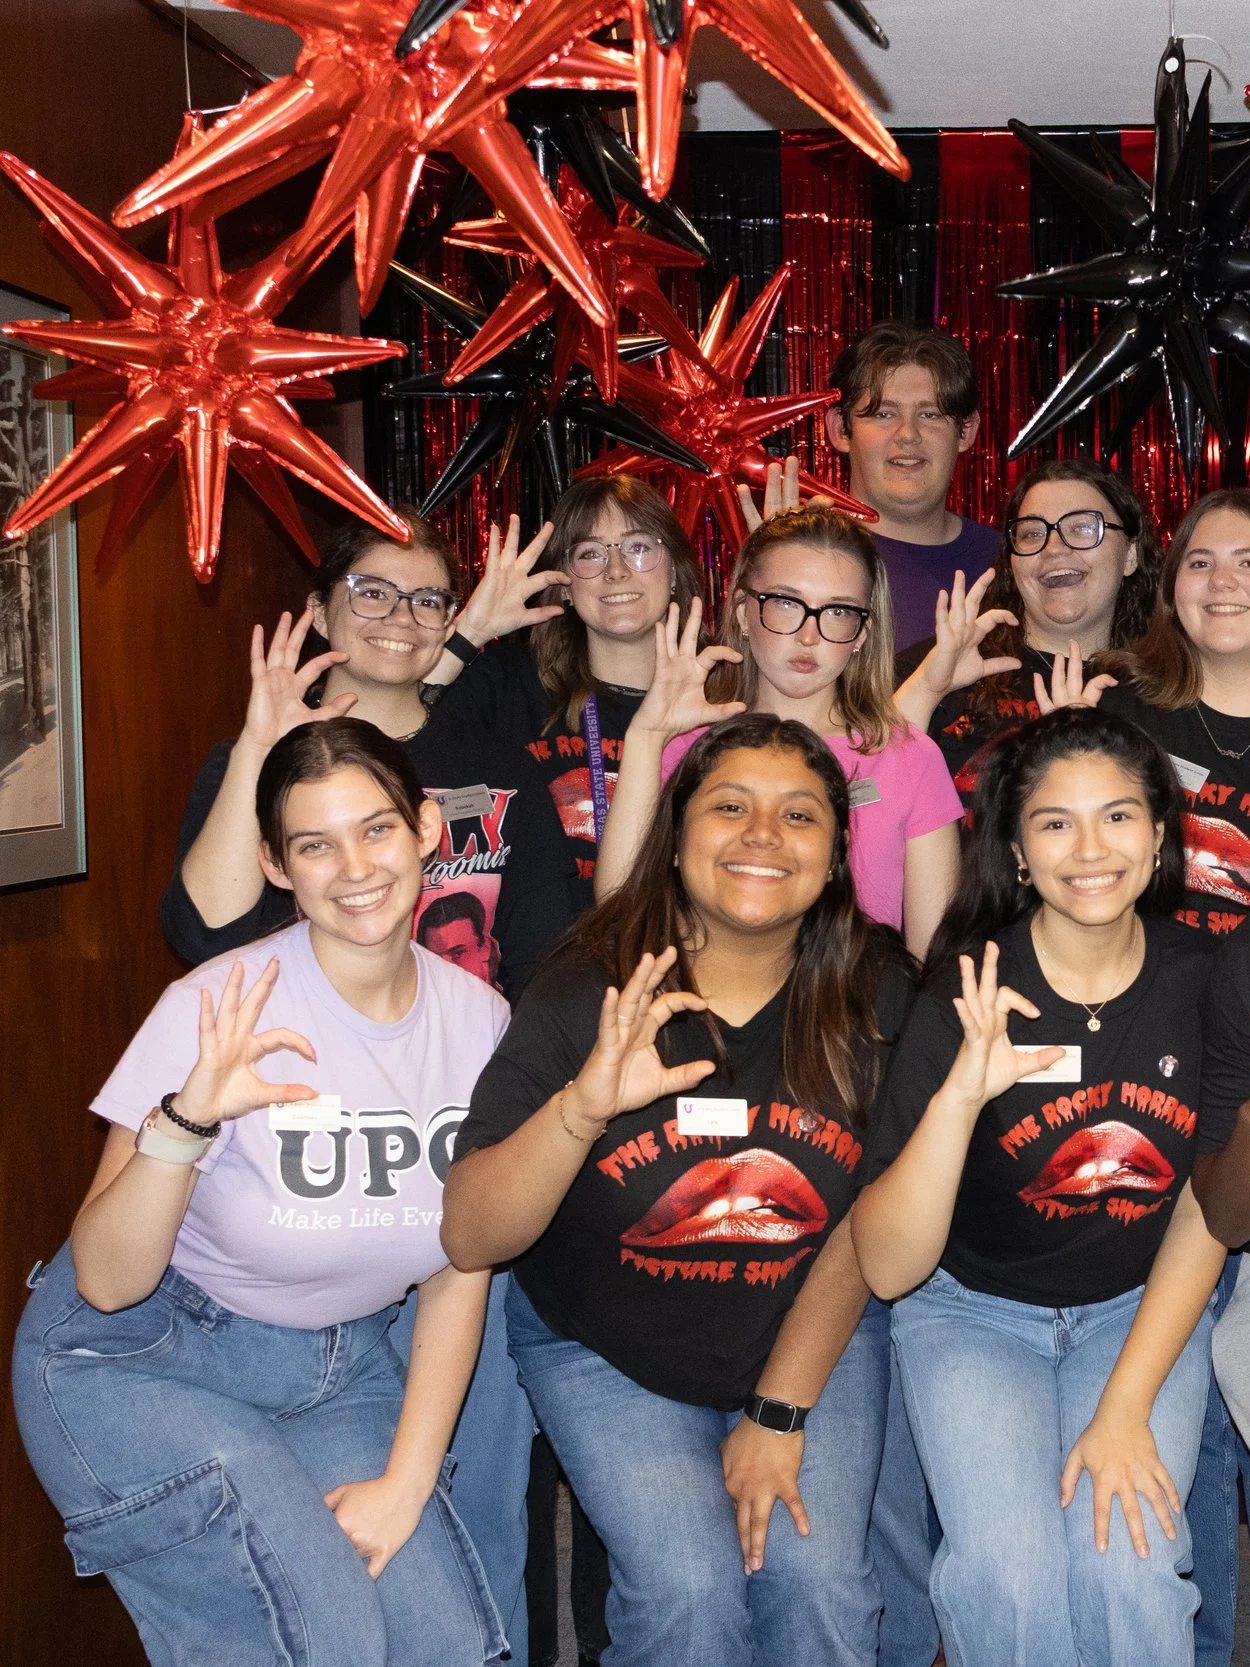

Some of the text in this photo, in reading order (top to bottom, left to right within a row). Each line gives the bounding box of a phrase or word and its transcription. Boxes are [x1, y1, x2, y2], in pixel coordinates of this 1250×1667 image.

[556, 735, 624, 764] ROK
[586, 701, 602, 766] UNIVERSITY
[593, 768, 606, 804] STATE
[421, 843, 512, 891] oomis
[998, 1080, 1198, 1160] THE ROCKY HORROR
[596, 1130, 661, 1187] THE
[268, 1206, 443, 1230] Make Life Eve
